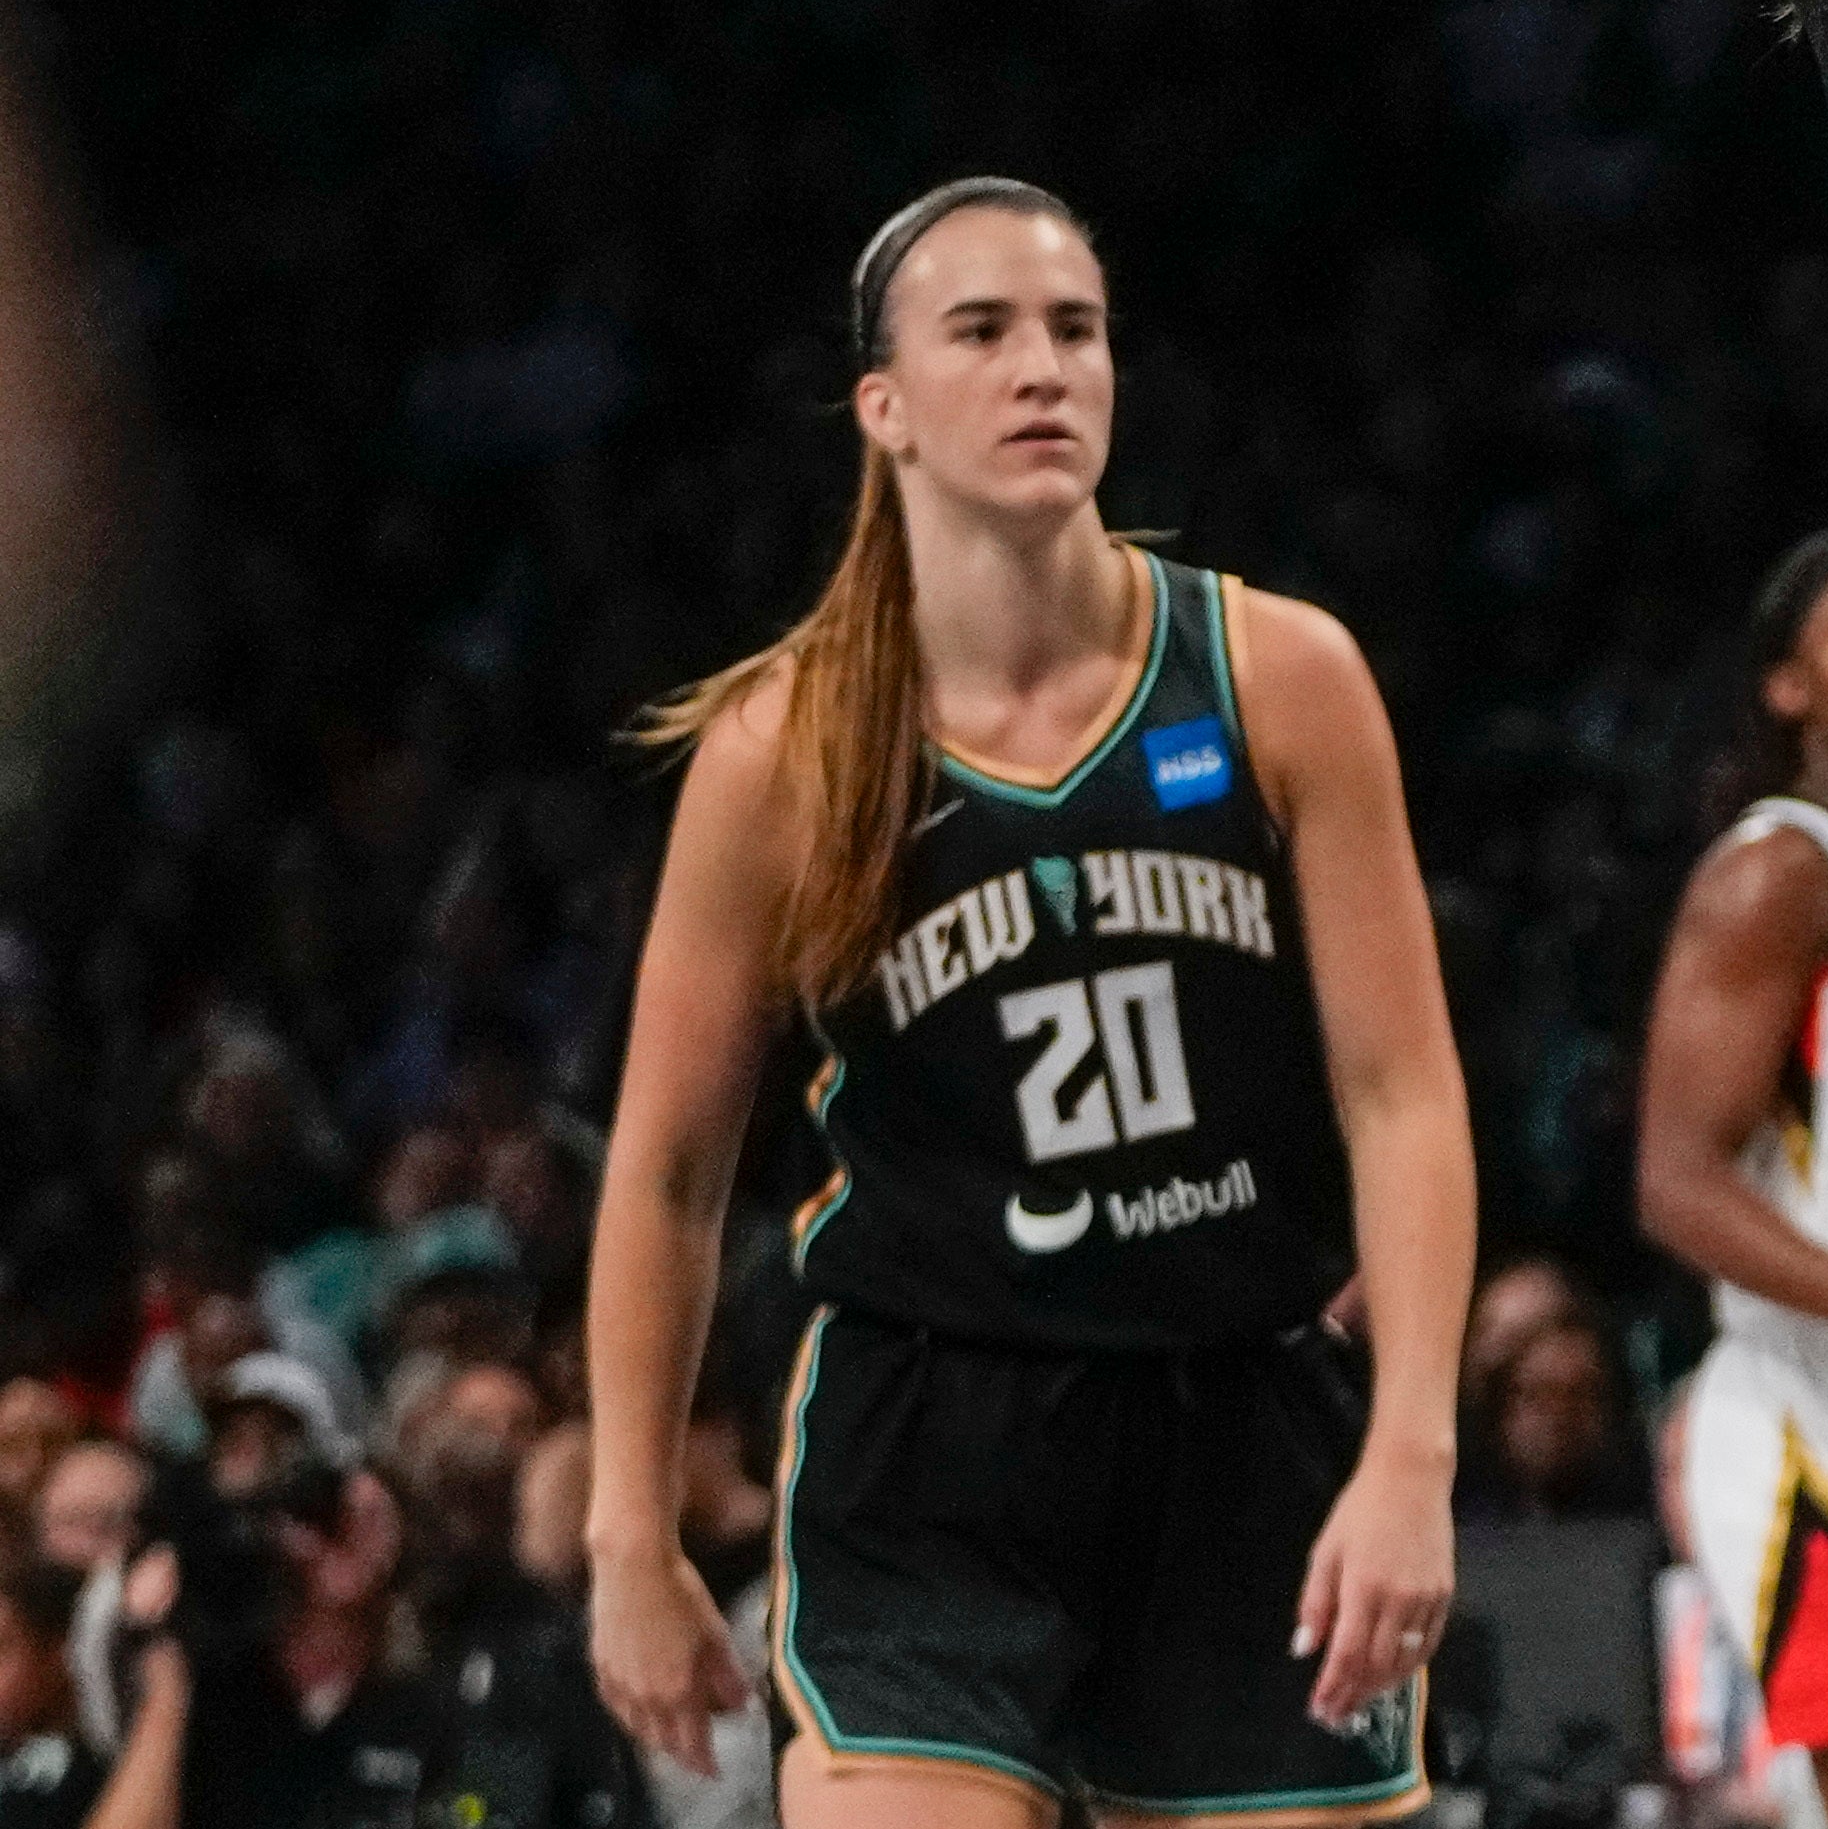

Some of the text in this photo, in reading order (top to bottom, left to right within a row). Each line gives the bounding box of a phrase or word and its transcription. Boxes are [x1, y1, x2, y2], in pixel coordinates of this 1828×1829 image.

[879, 849, 1275, 1032] NEW YORK
[998, 960, 1196, 1165] 20
[1107, 1160, 1257, 1239] Webull
